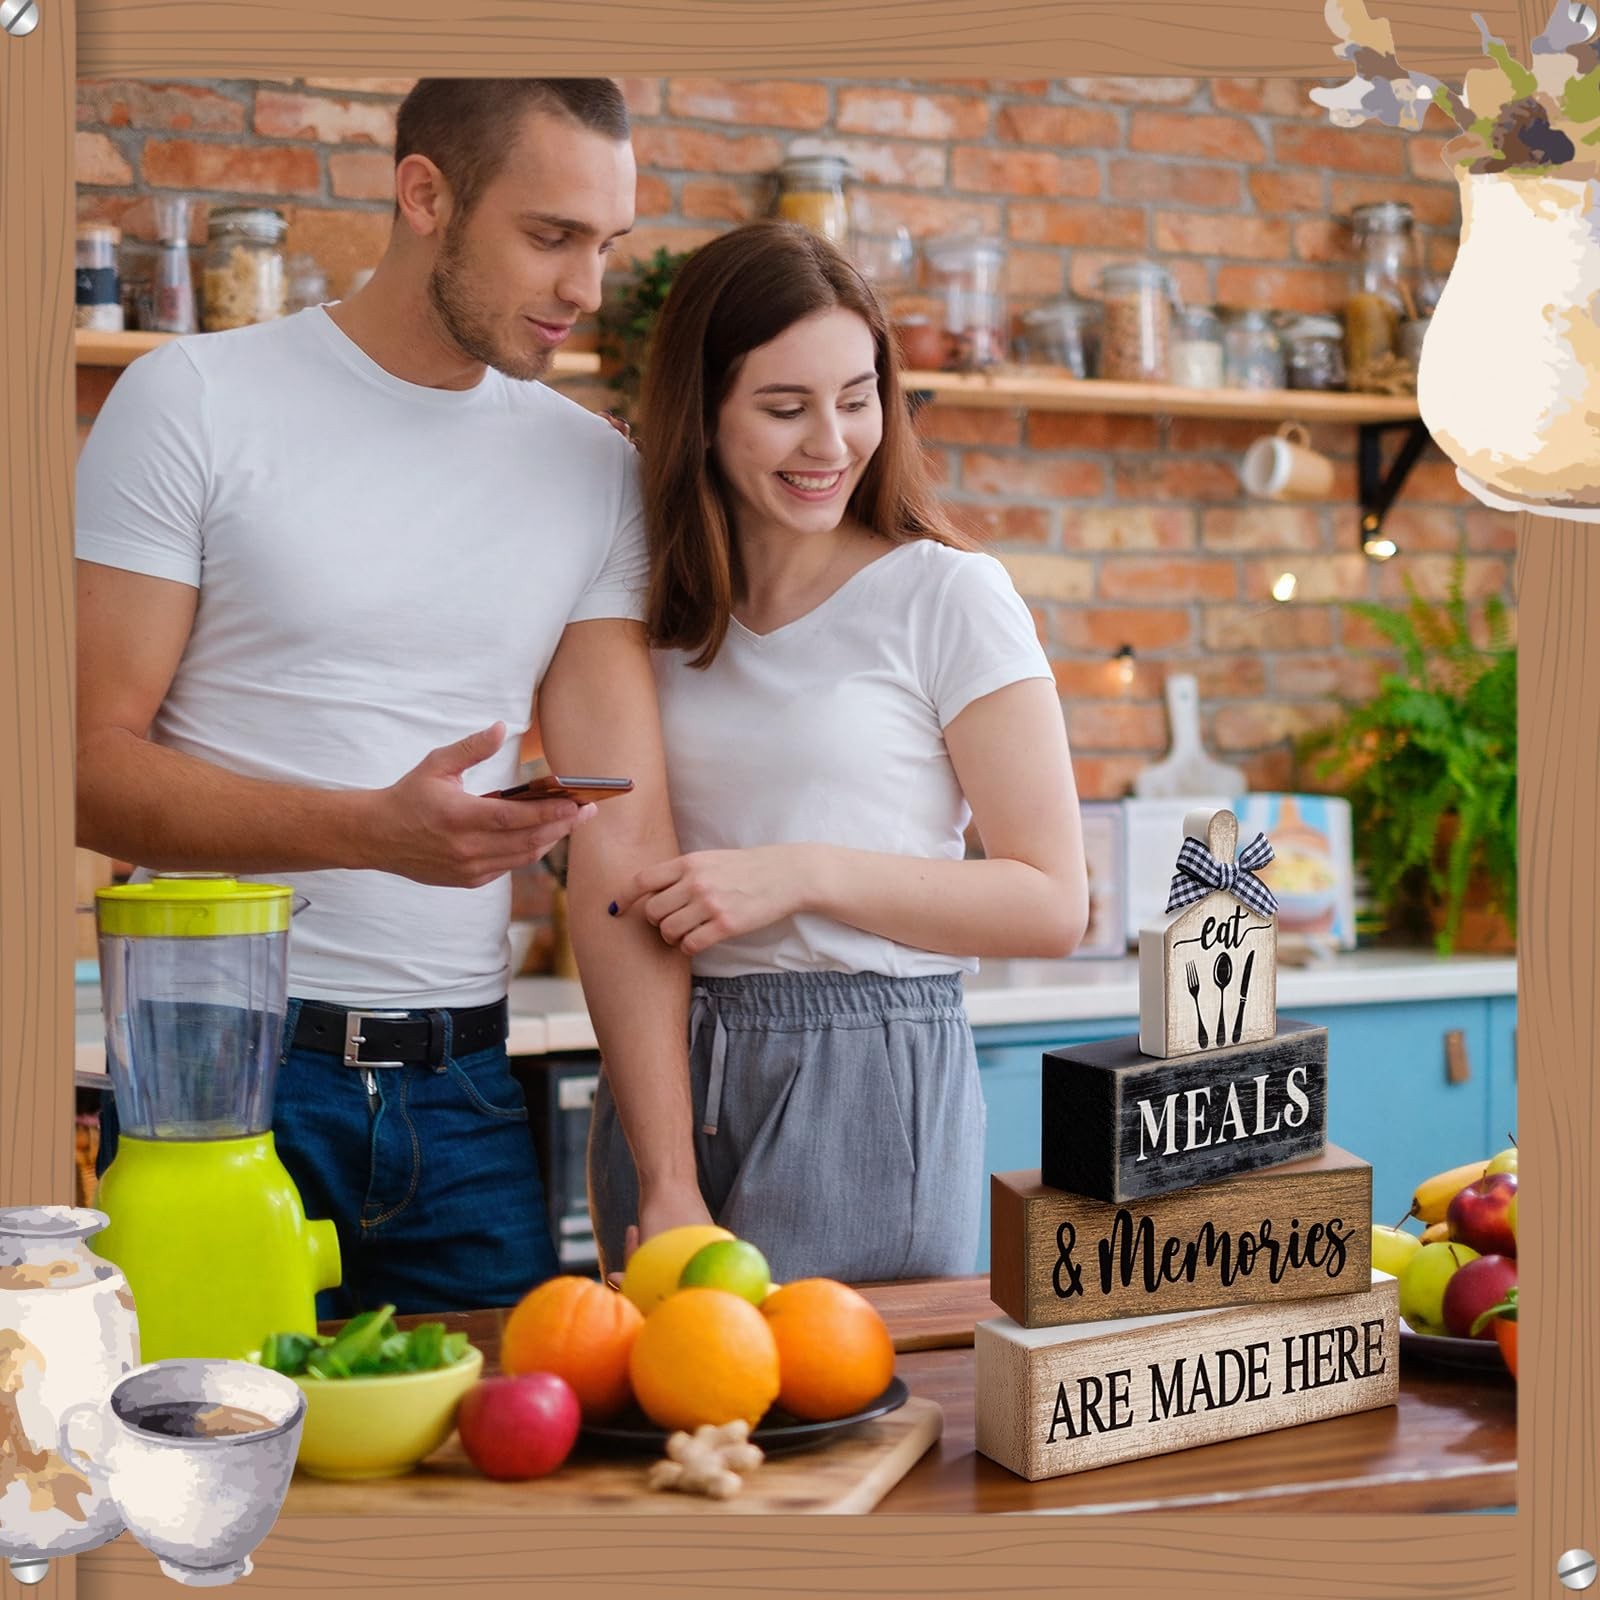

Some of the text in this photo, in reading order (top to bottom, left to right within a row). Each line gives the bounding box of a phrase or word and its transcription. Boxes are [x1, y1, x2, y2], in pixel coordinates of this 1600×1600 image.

[1173, 905, 1272, 950] eat
[1137, 1066, 1309, 1162] MEALS
[1052, 1208, 1355, 1298] & Memories
[1046, 1319, 1386, 1444] ARE MADE HERE
